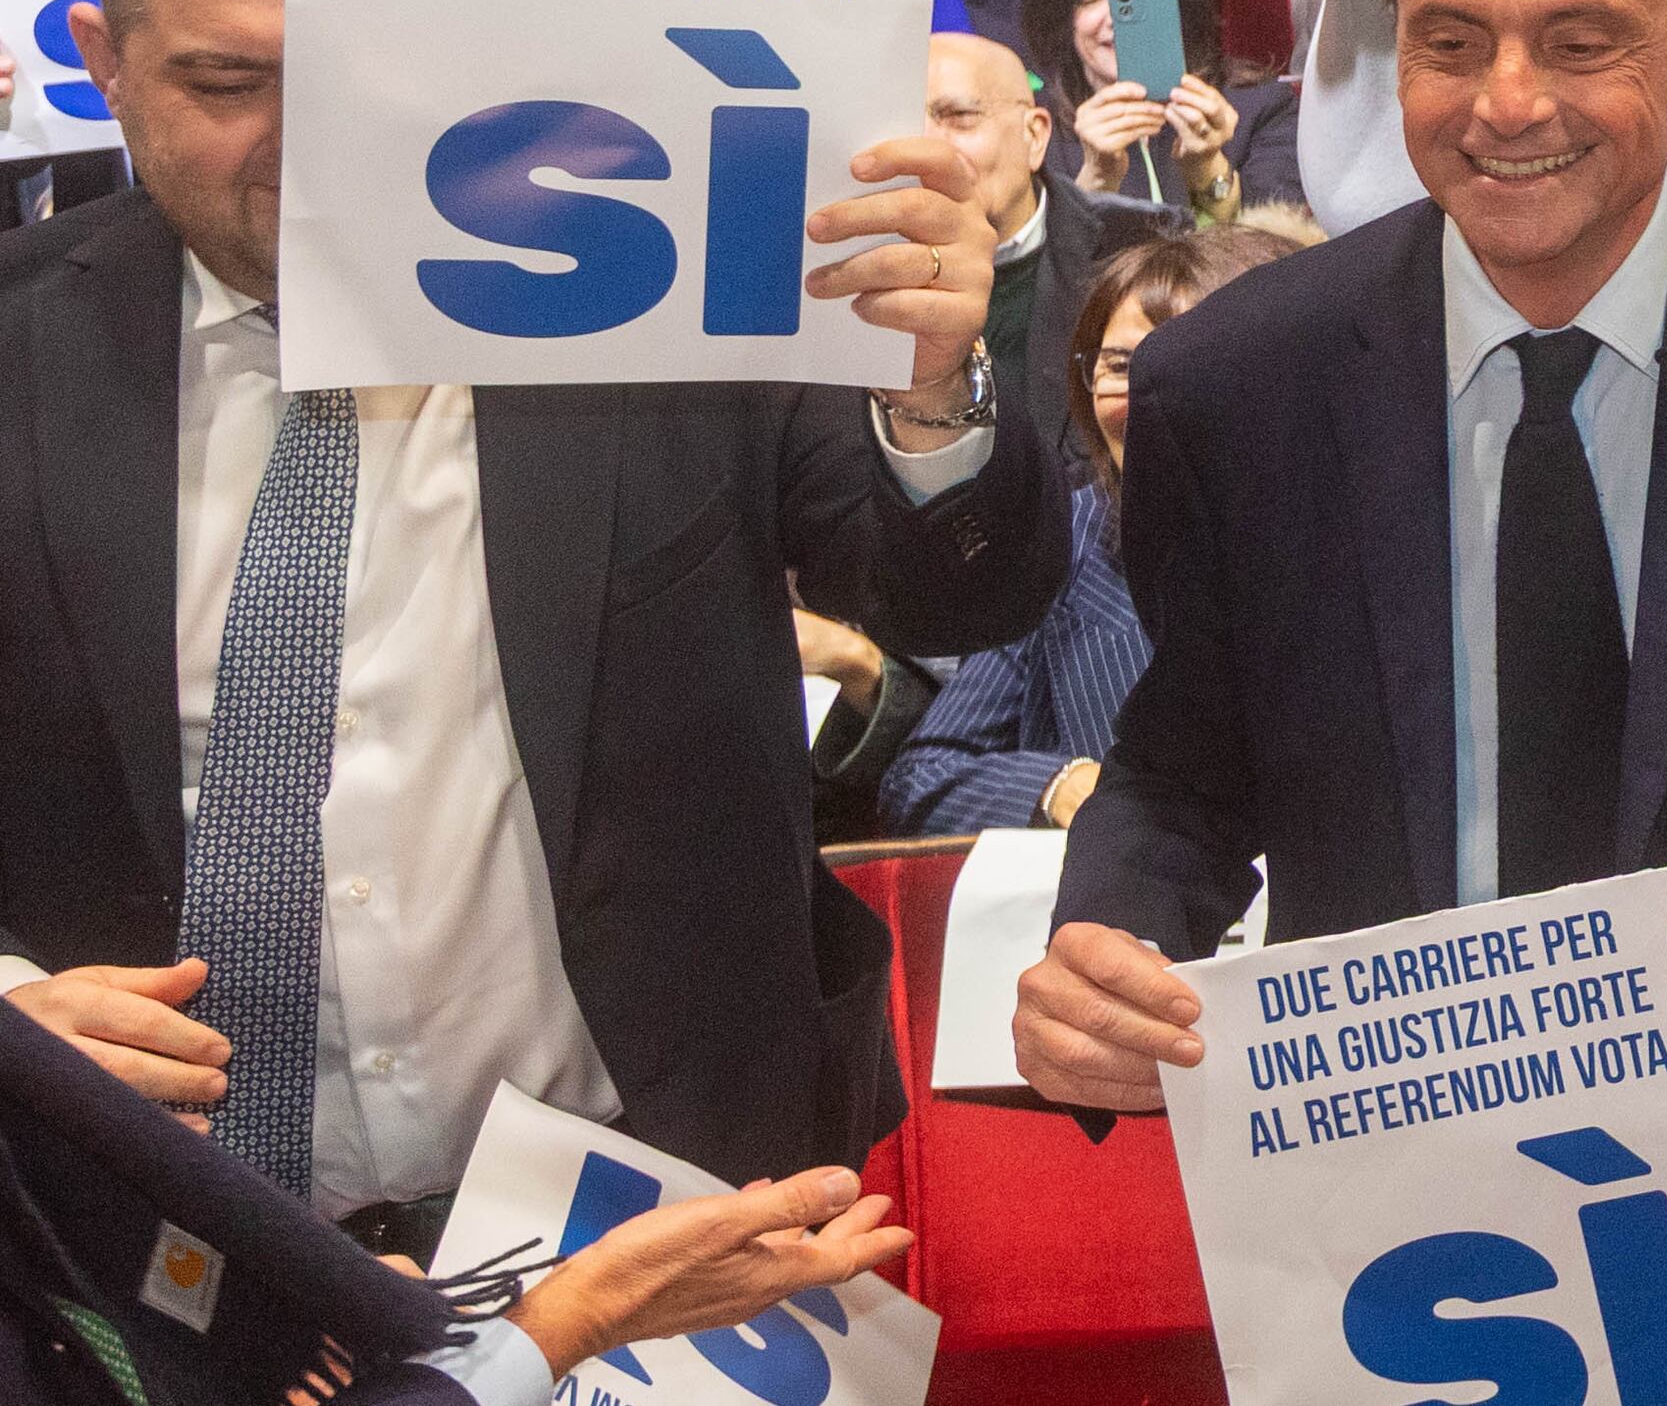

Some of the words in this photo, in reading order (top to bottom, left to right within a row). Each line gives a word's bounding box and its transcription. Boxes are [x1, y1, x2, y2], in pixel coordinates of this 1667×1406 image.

[1257, 966, 1337, 1023] DUE
[1342, 925, 1536, 1010] CARRIERE
[1540, 910, 1617, 966] PER
[1248, 1034, 1332, 1090] UNA
[1338, 994, 1526, 1072] GIUSTIZIA
[1531, 967, 1654, 1033] FORTE
[1250, 1108, 1299, 1157] AL
[1305, 1050, 1566, 1145] REFERENDUM
